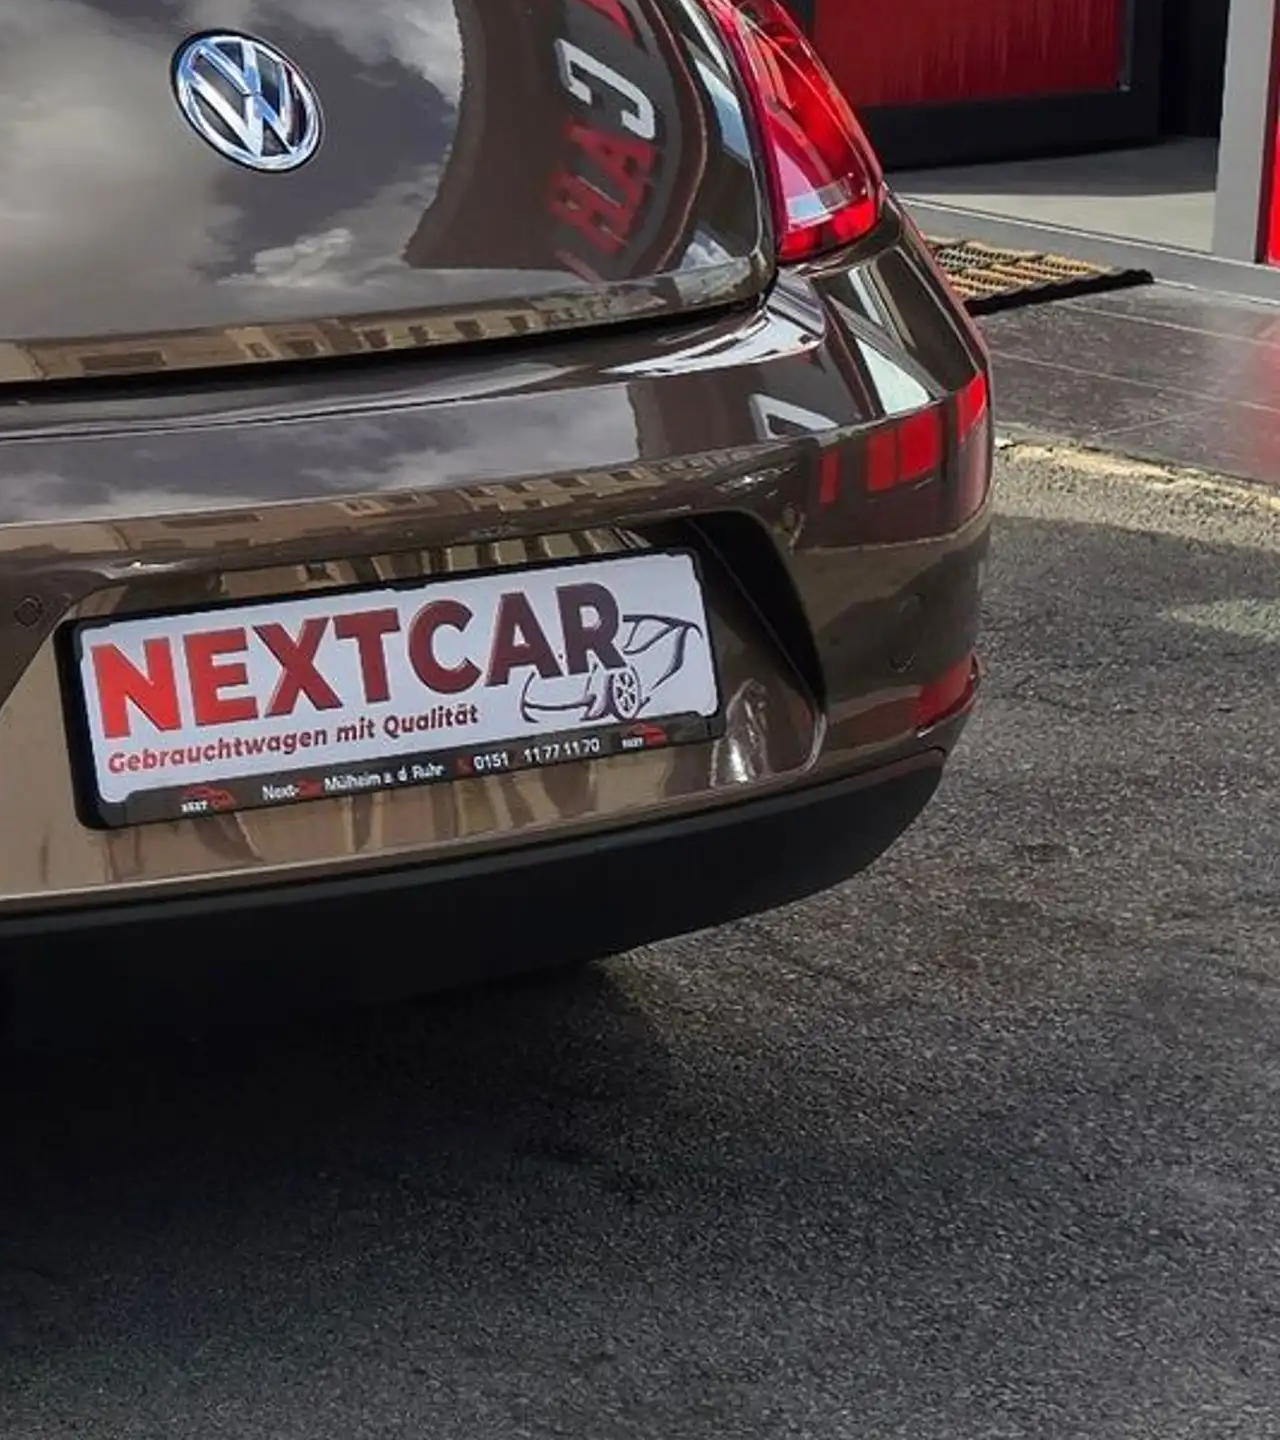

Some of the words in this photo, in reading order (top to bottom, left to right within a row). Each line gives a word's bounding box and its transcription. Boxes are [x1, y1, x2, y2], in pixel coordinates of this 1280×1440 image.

[91, 582, 630, 739] NEXTCAR
[107, 727, 328, 775] Gebrauchtwagen
[336, 719, 376, 744] mit
[382, 703, 480, 742] Qualität
[473, 752, 510, 770] 0151
